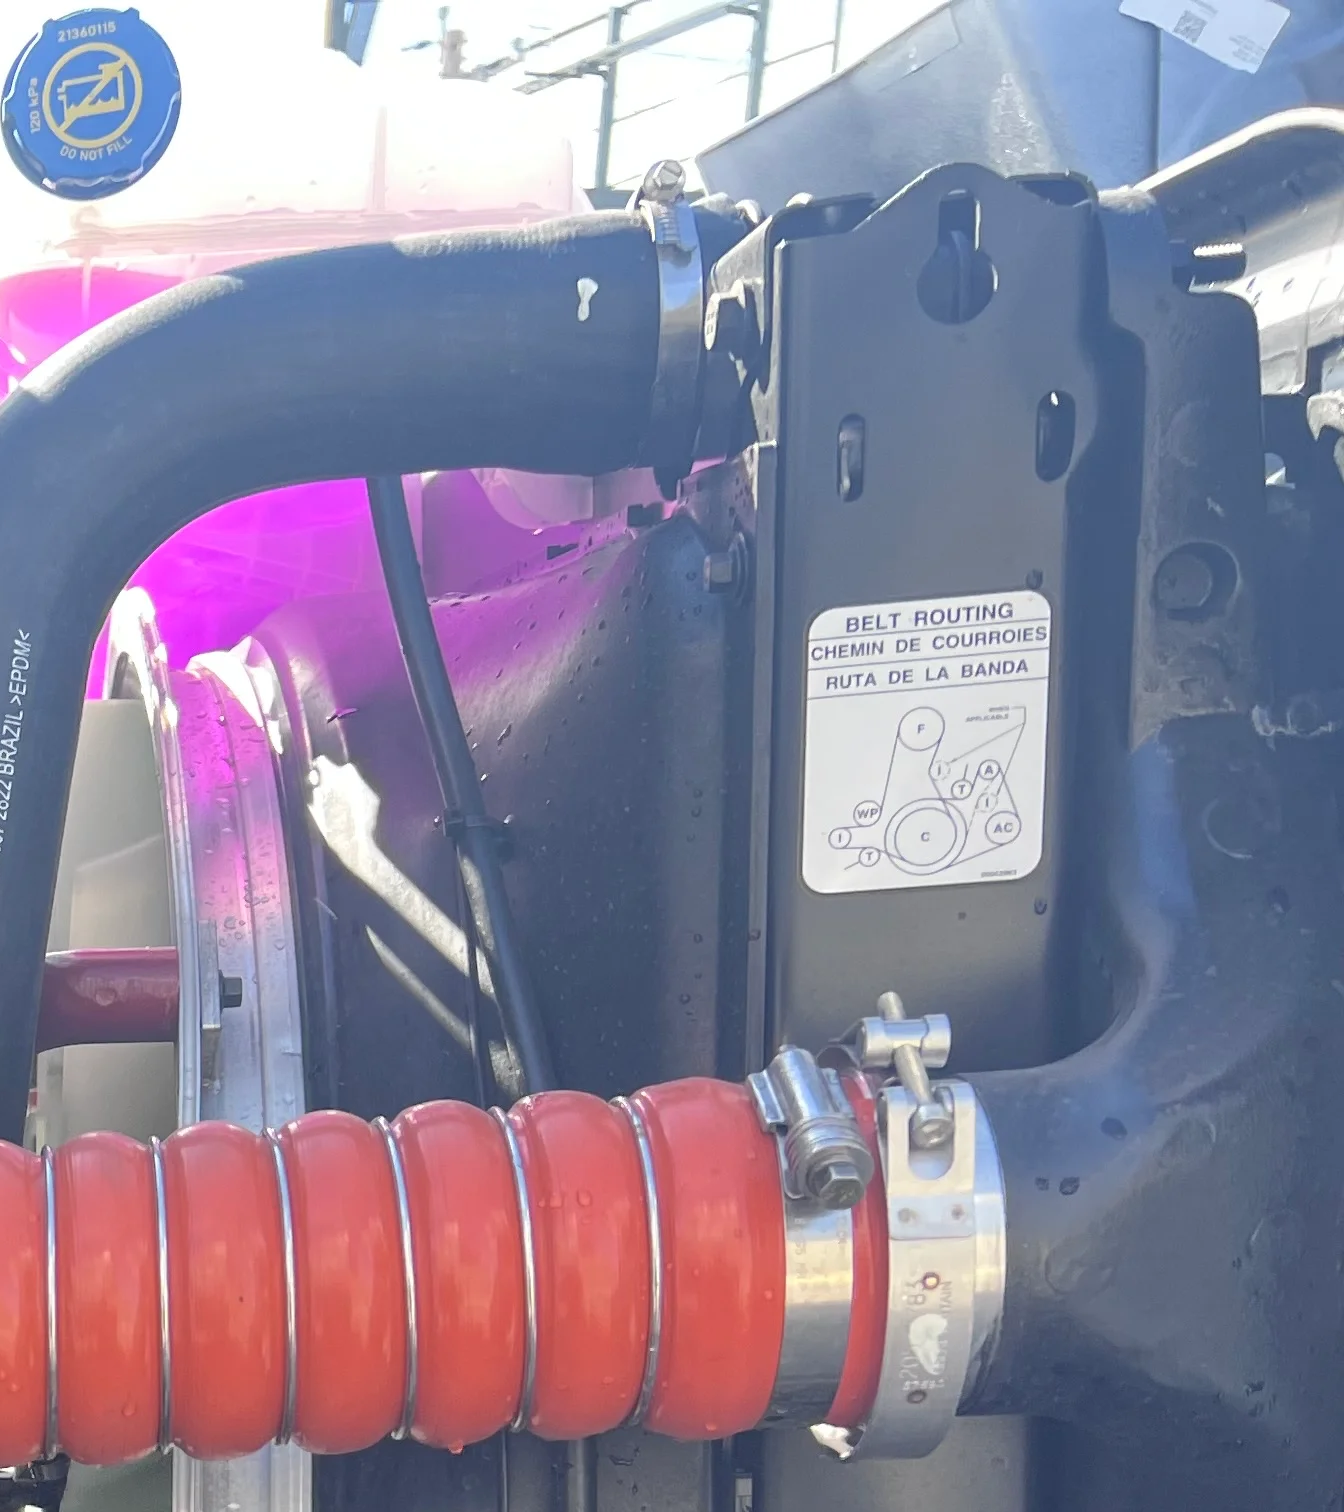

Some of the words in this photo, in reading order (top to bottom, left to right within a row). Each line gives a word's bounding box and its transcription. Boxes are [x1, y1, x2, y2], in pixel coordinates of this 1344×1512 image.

[57, 21, 117, 43] 21360115
[27, 77, 38, 106] kPa
[59, 146, 77, 160] DO
[80, 148, 104, 162] NOT
[106, 135, 133, 156] FILL
[845, 612, 901, 633] BELT
[914, 603, 1014, 627] ROUTING
[811, 640, 884, 661] CHEMIN
[895, 638, 921, 653] DE
[932, 626, 1047, 650] COURROIES
[826, 673, 877, 691] RUTA
[888, 669, 913, 685] DE
[925, 667, 949, 682] LA
[961, 659, 1029, 678] BANDA
[917, 724, 926, 734] F
[984, 765, 994, 775] A
[958, 785, 966, 795] T
[857, 808, 879, 819] WP
[993, 822, 1013, 833] AC
[921, 832, 930, 842] C
[865, 852, 873, 861] T
